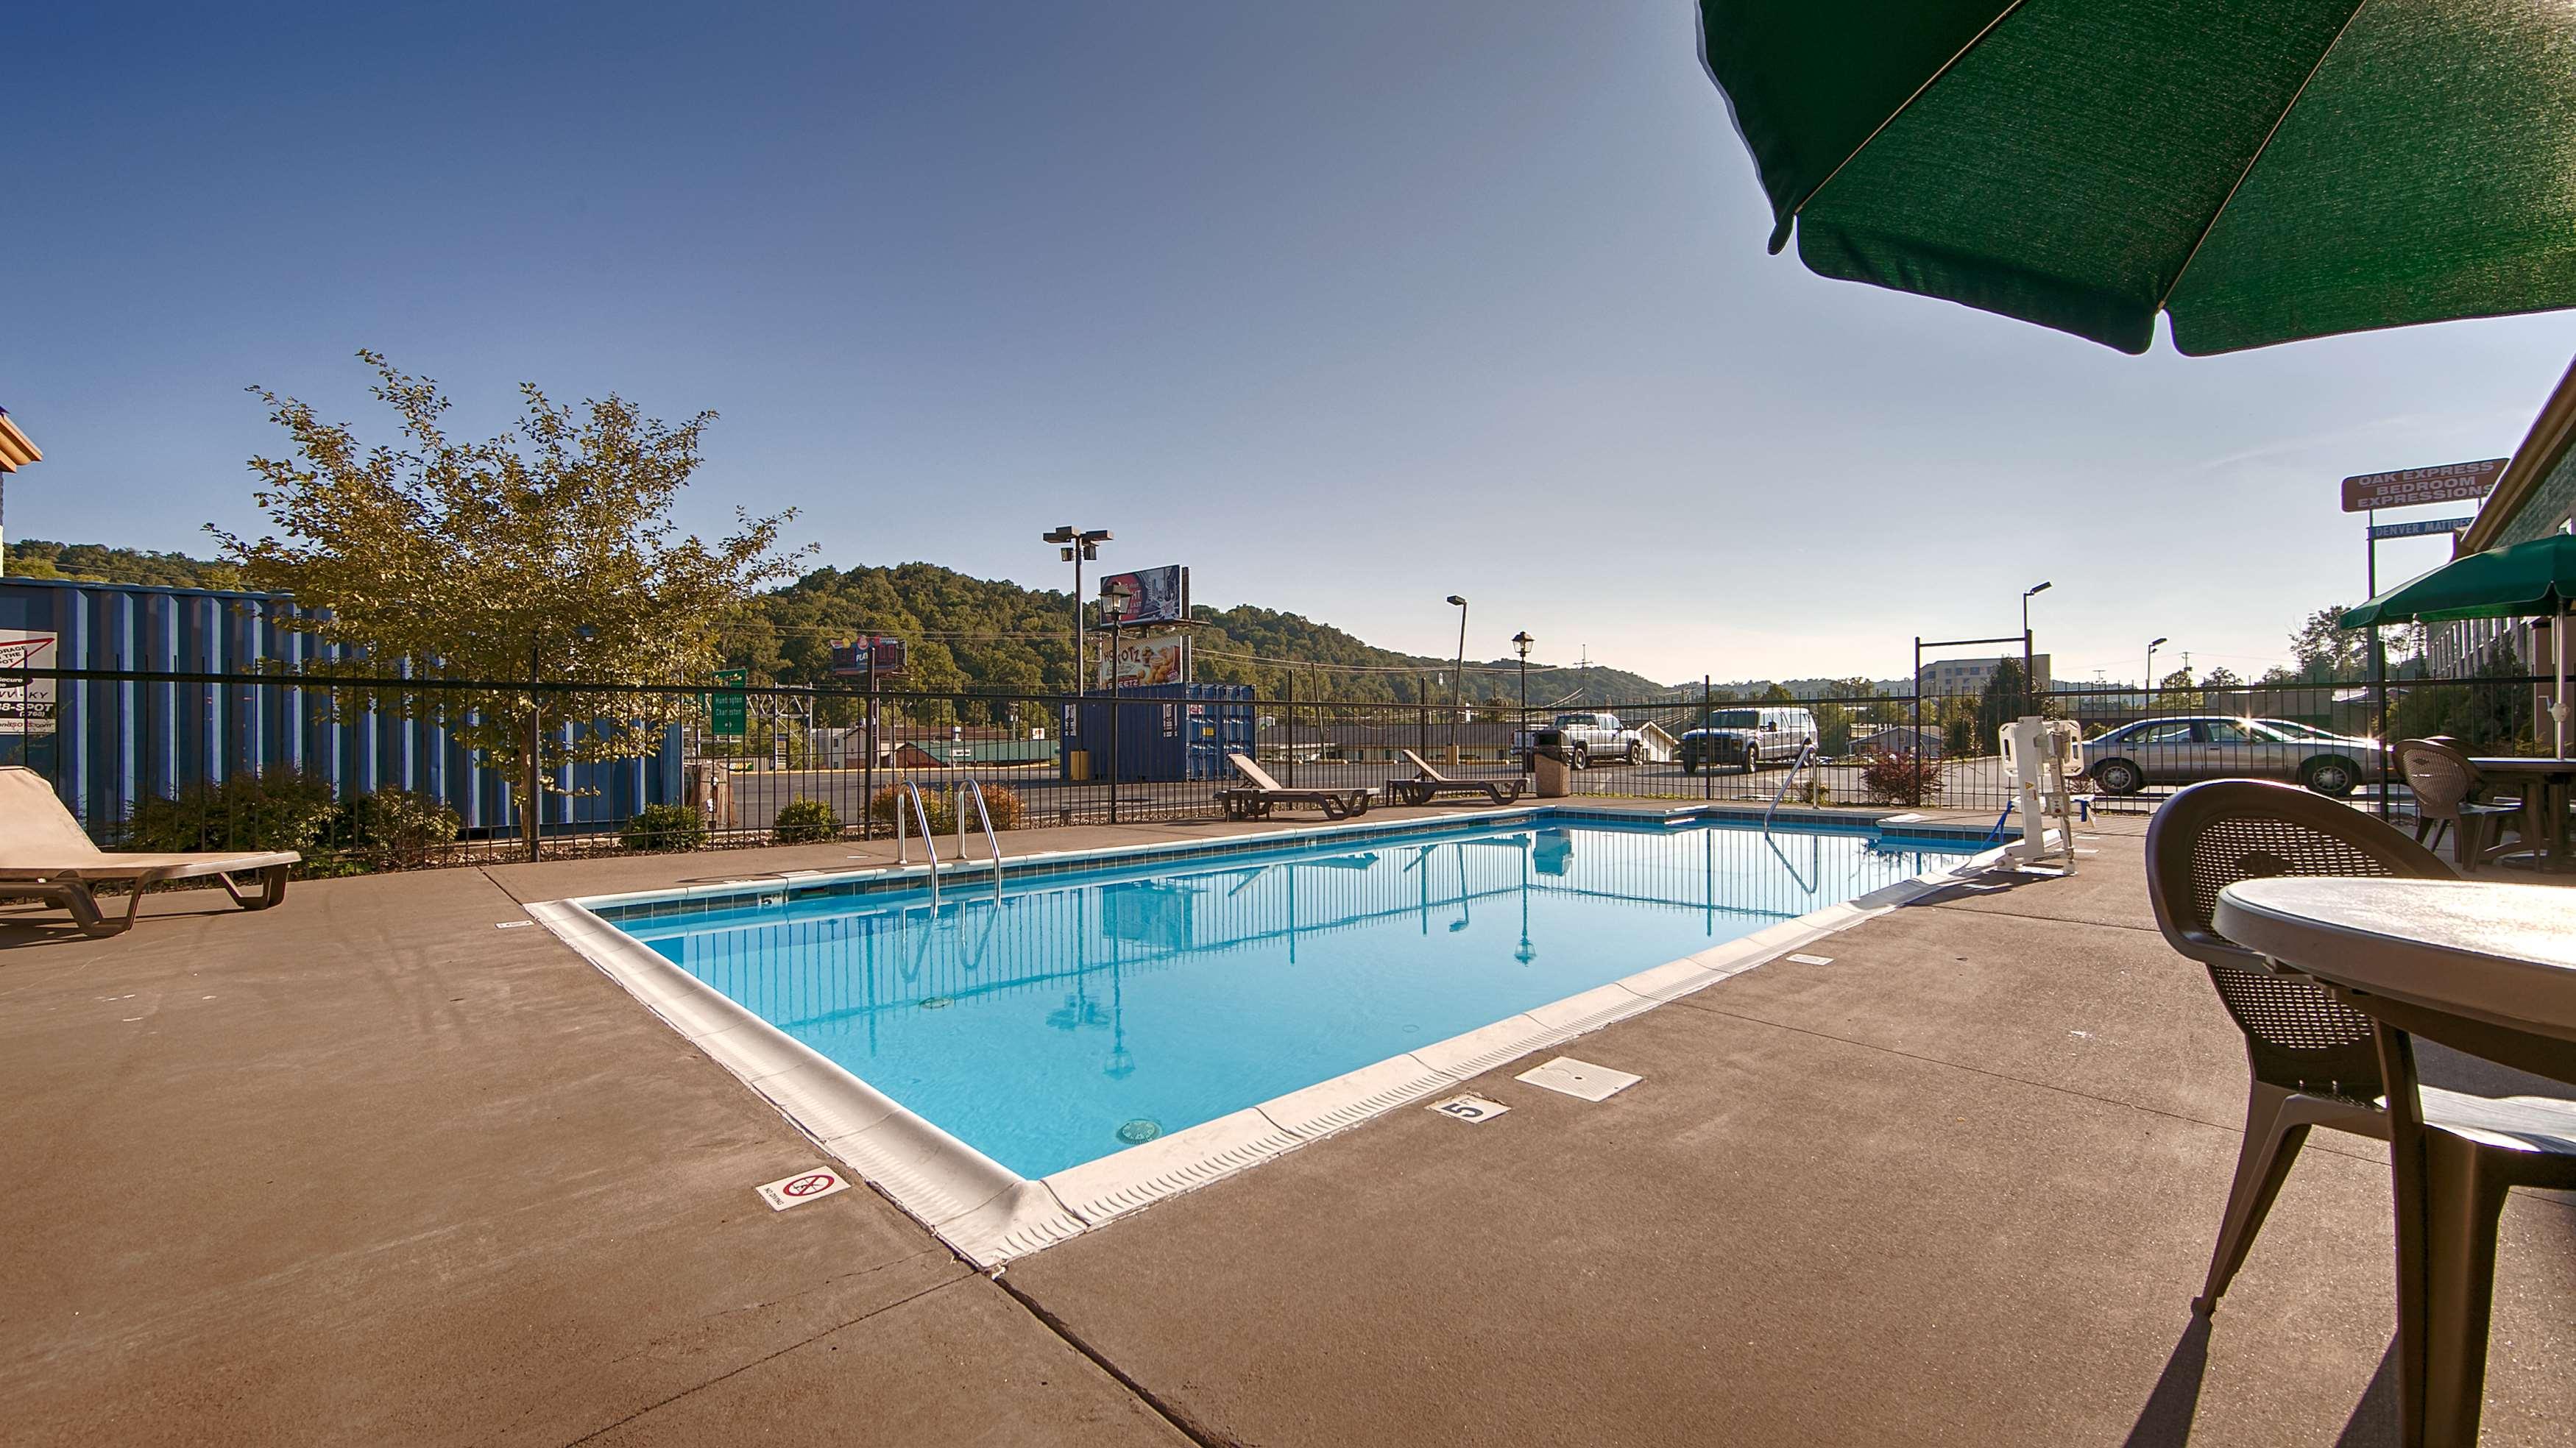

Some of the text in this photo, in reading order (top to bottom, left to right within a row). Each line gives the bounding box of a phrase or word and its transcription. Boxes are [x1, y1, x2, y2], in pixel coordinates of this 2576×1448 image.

[2358, 462, 2495, 486] OAK EXPRESS
[2357, 483, 2494, 508] EXPRESSIONS
[2376, 476, 2476, 496] BEDROOM
[2376, 517, 2472, 537] DENVER MATTRES
[1107, 679, 1139, 689] SEETZ
[715, 696, 742, 705] Huntngton
[1440, 1103, 1484, 1118] 5
